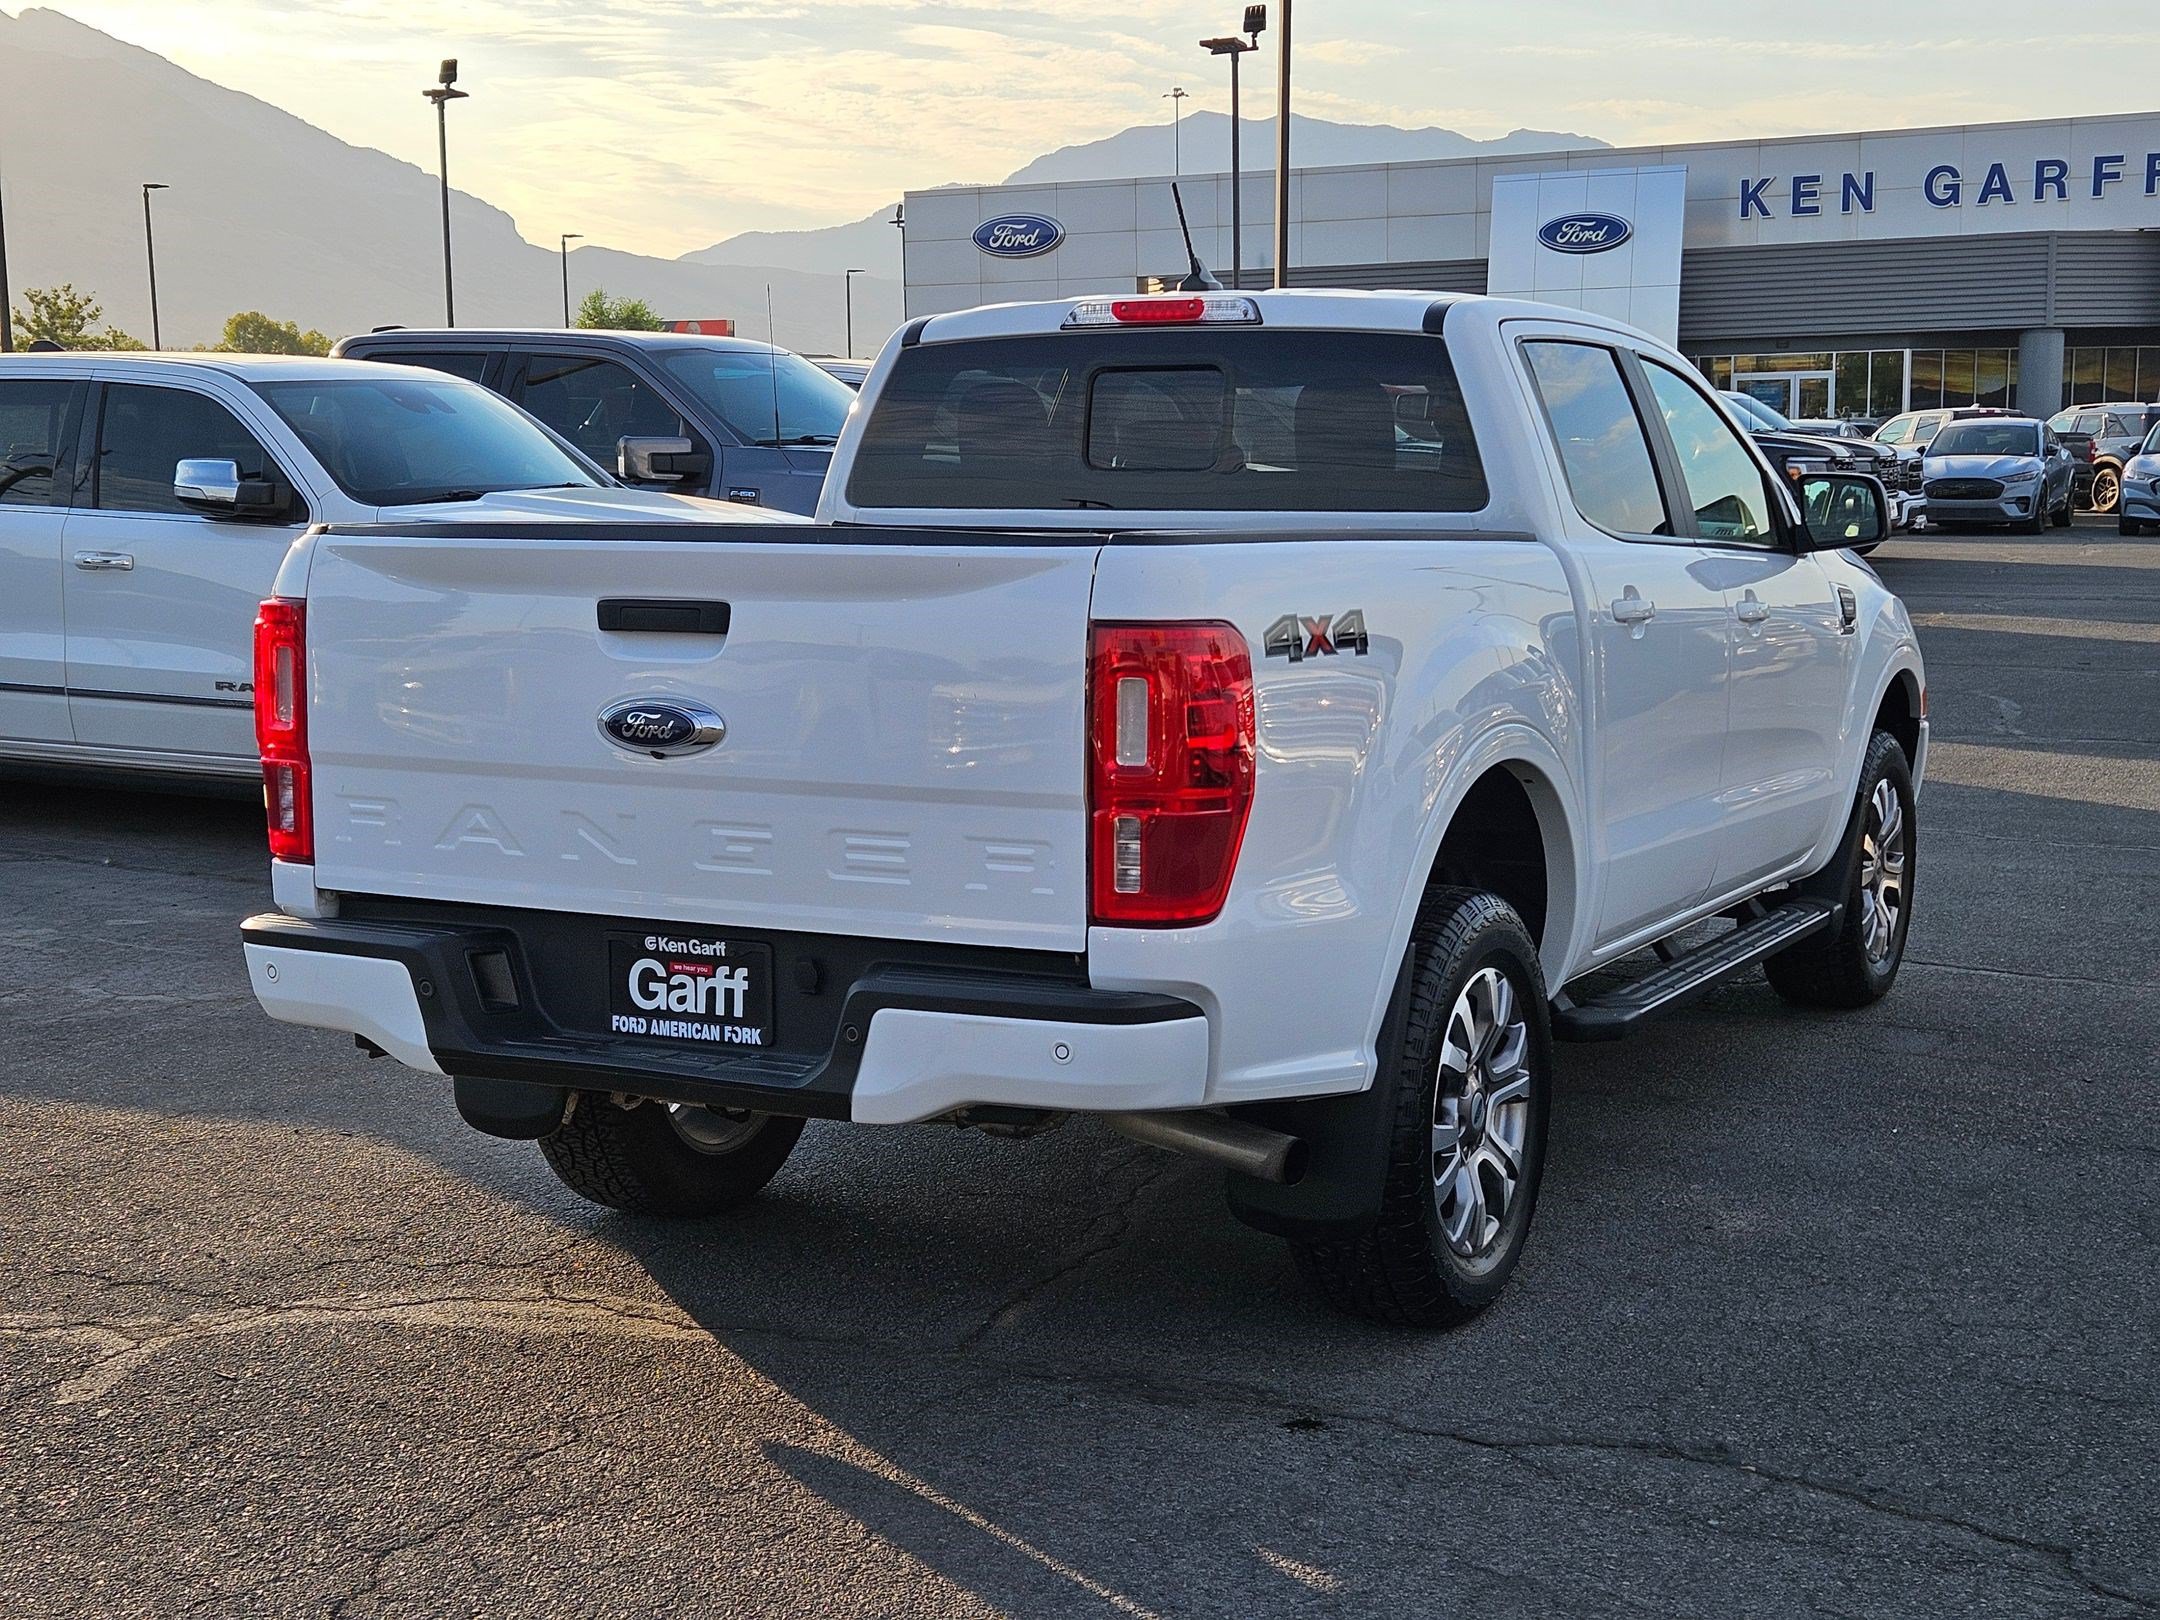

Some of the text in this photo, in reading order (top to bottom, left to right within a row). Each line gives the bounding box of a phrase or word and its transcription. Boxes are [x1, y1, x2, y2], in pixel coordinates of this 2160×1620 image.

[1739, 170, 1876, 220] KEN
[988, 223, 1040, 248] Ford
[1556, 221, 1609, 243] Ford
[215, 681, 255, 692] RA
[622, 711, 675, 739] Ford
[332, 792, 1056, 896] RANGER
[657, 936, 726, 957] Ken Garff
[696, 966, 708, 974] you
[628, 958, 749, 1018] Garff
[612, 1015, 762, 1046] FORD AMERICAN FORK
